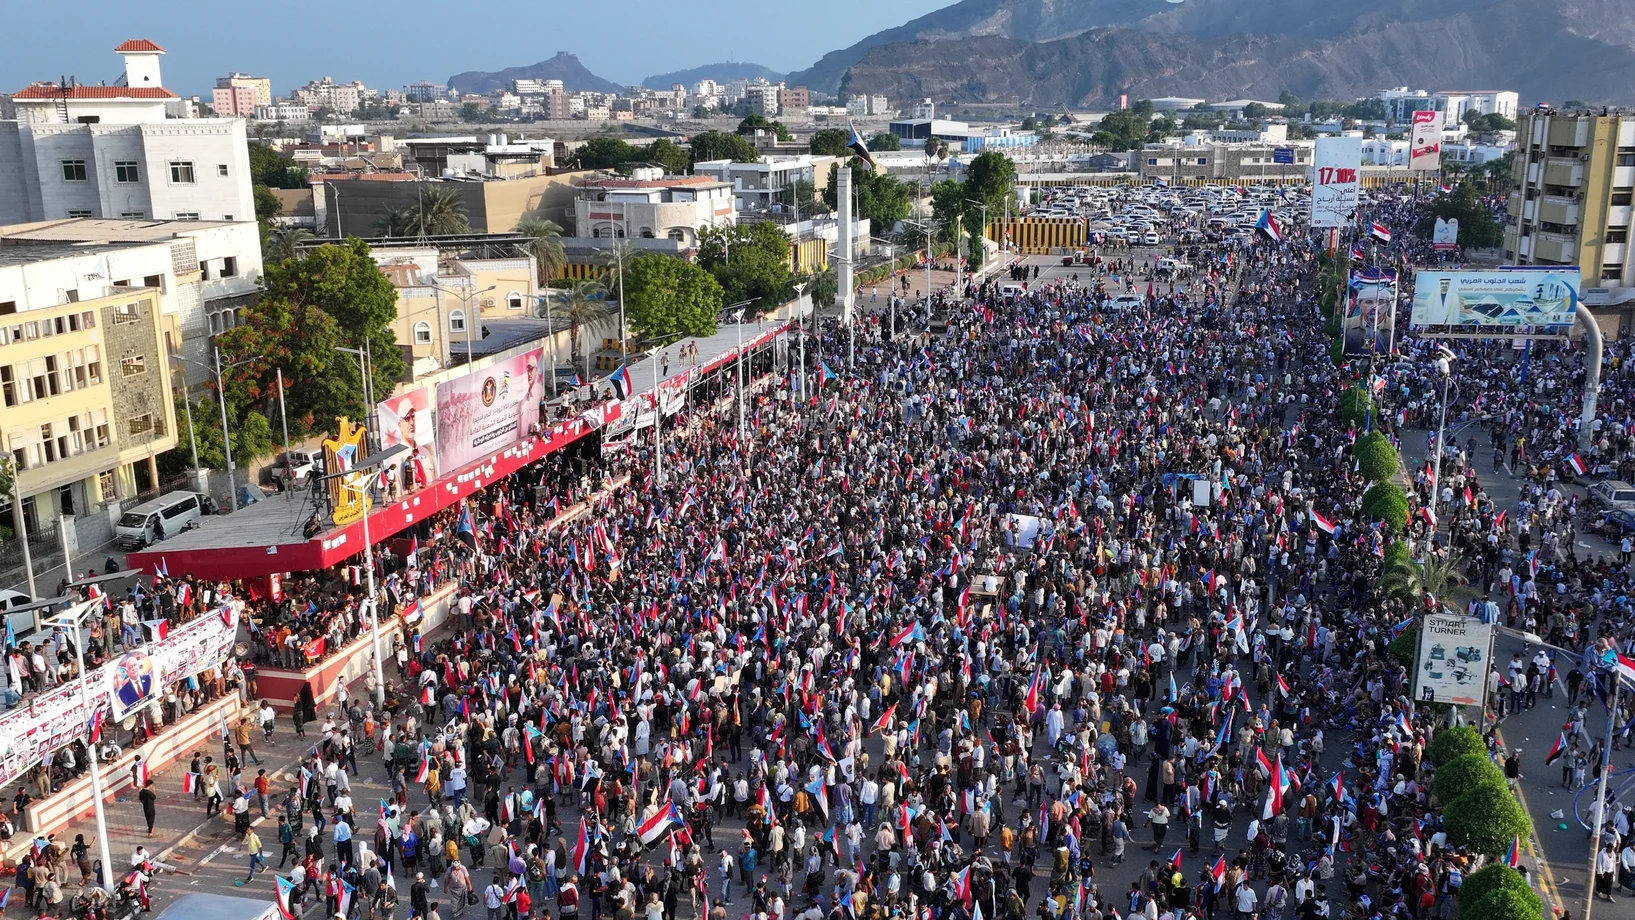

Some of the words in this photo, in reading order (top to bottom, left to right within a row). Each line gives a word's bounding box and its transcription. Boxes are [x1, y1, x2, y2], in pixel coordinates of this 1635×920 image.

[1318, 167, 1356, 185] 17.10%
[1508, 277, 1526, 285] شعب
[1429, 626, 1467, 636] TURNER
